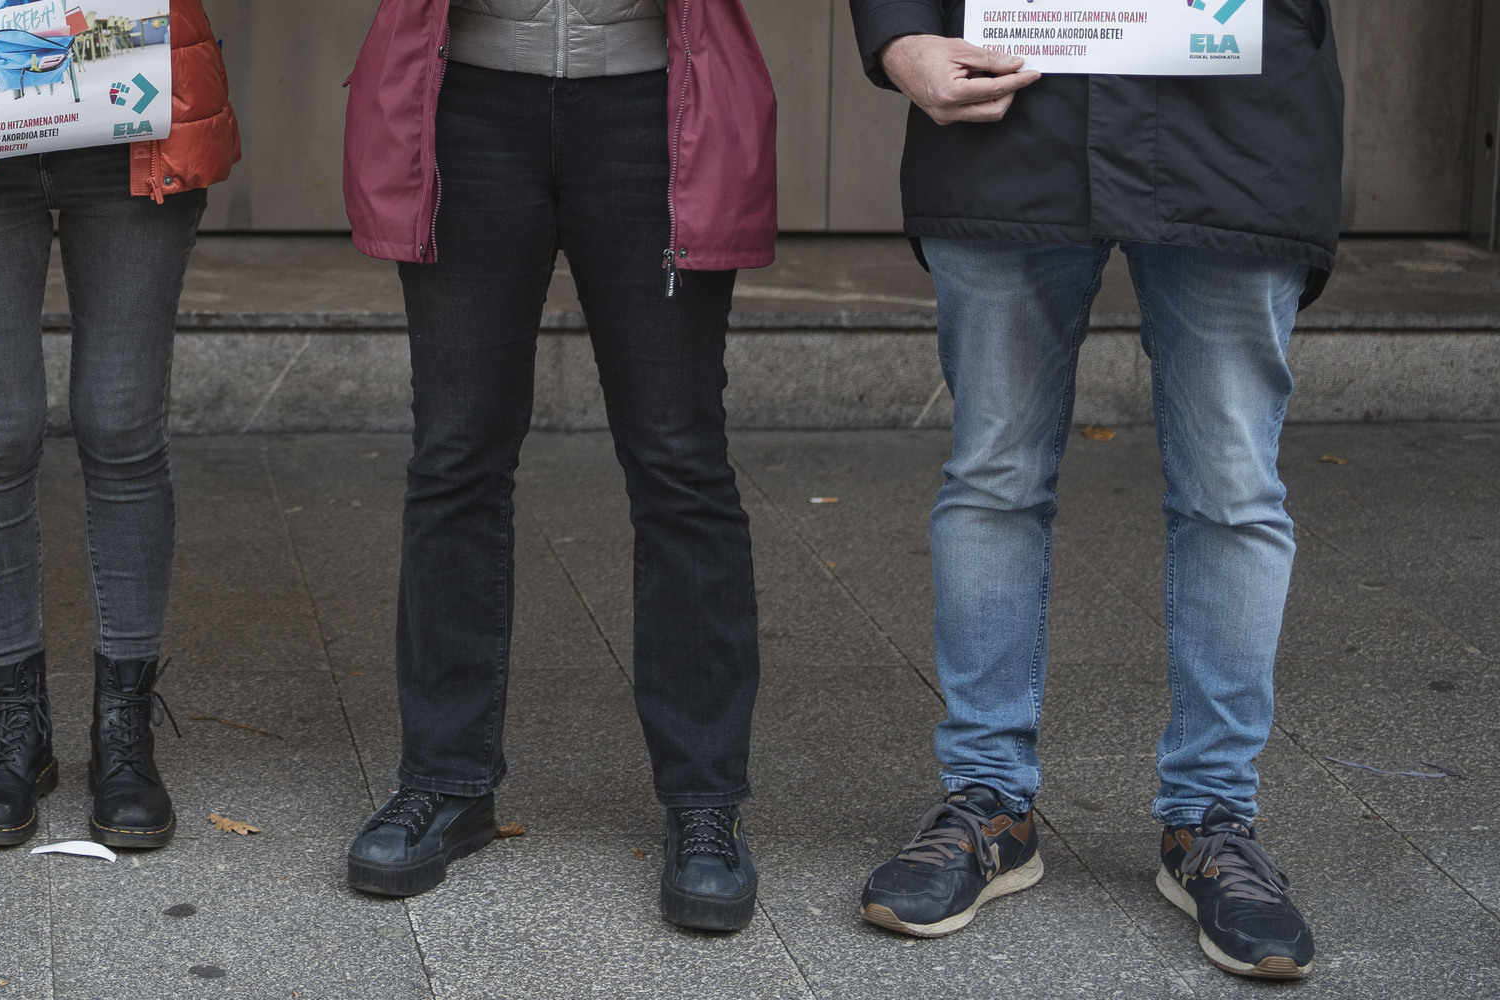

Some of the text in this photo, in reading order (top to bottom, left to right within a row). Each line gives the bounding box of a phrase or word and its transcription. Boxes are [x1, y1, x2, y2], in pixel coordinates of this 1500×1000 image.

[1, 1, 56, 31] GREBA!
[984, 11, 1147, 23] GIZARTE EKIMENEKO HITZARMENA ORAIN!
[983, 28, 1123, 40] GREBA AMAIERAKO AKORDIOA BETE!
[1014, 45, 1042, 56] ORDUA
[1042, 46, 1086, 56] MURRIZTU!
[1190, 34, 1240, 53] ELA
[7, 116, 52, 131] HITZARMENA
[54, 113, 79, 125] ORAIN!
[113, 120, 153, 136] ELA
[1, 131, 39, 143] AKORDIOA
[39, 129, 59, 139] BETE!
